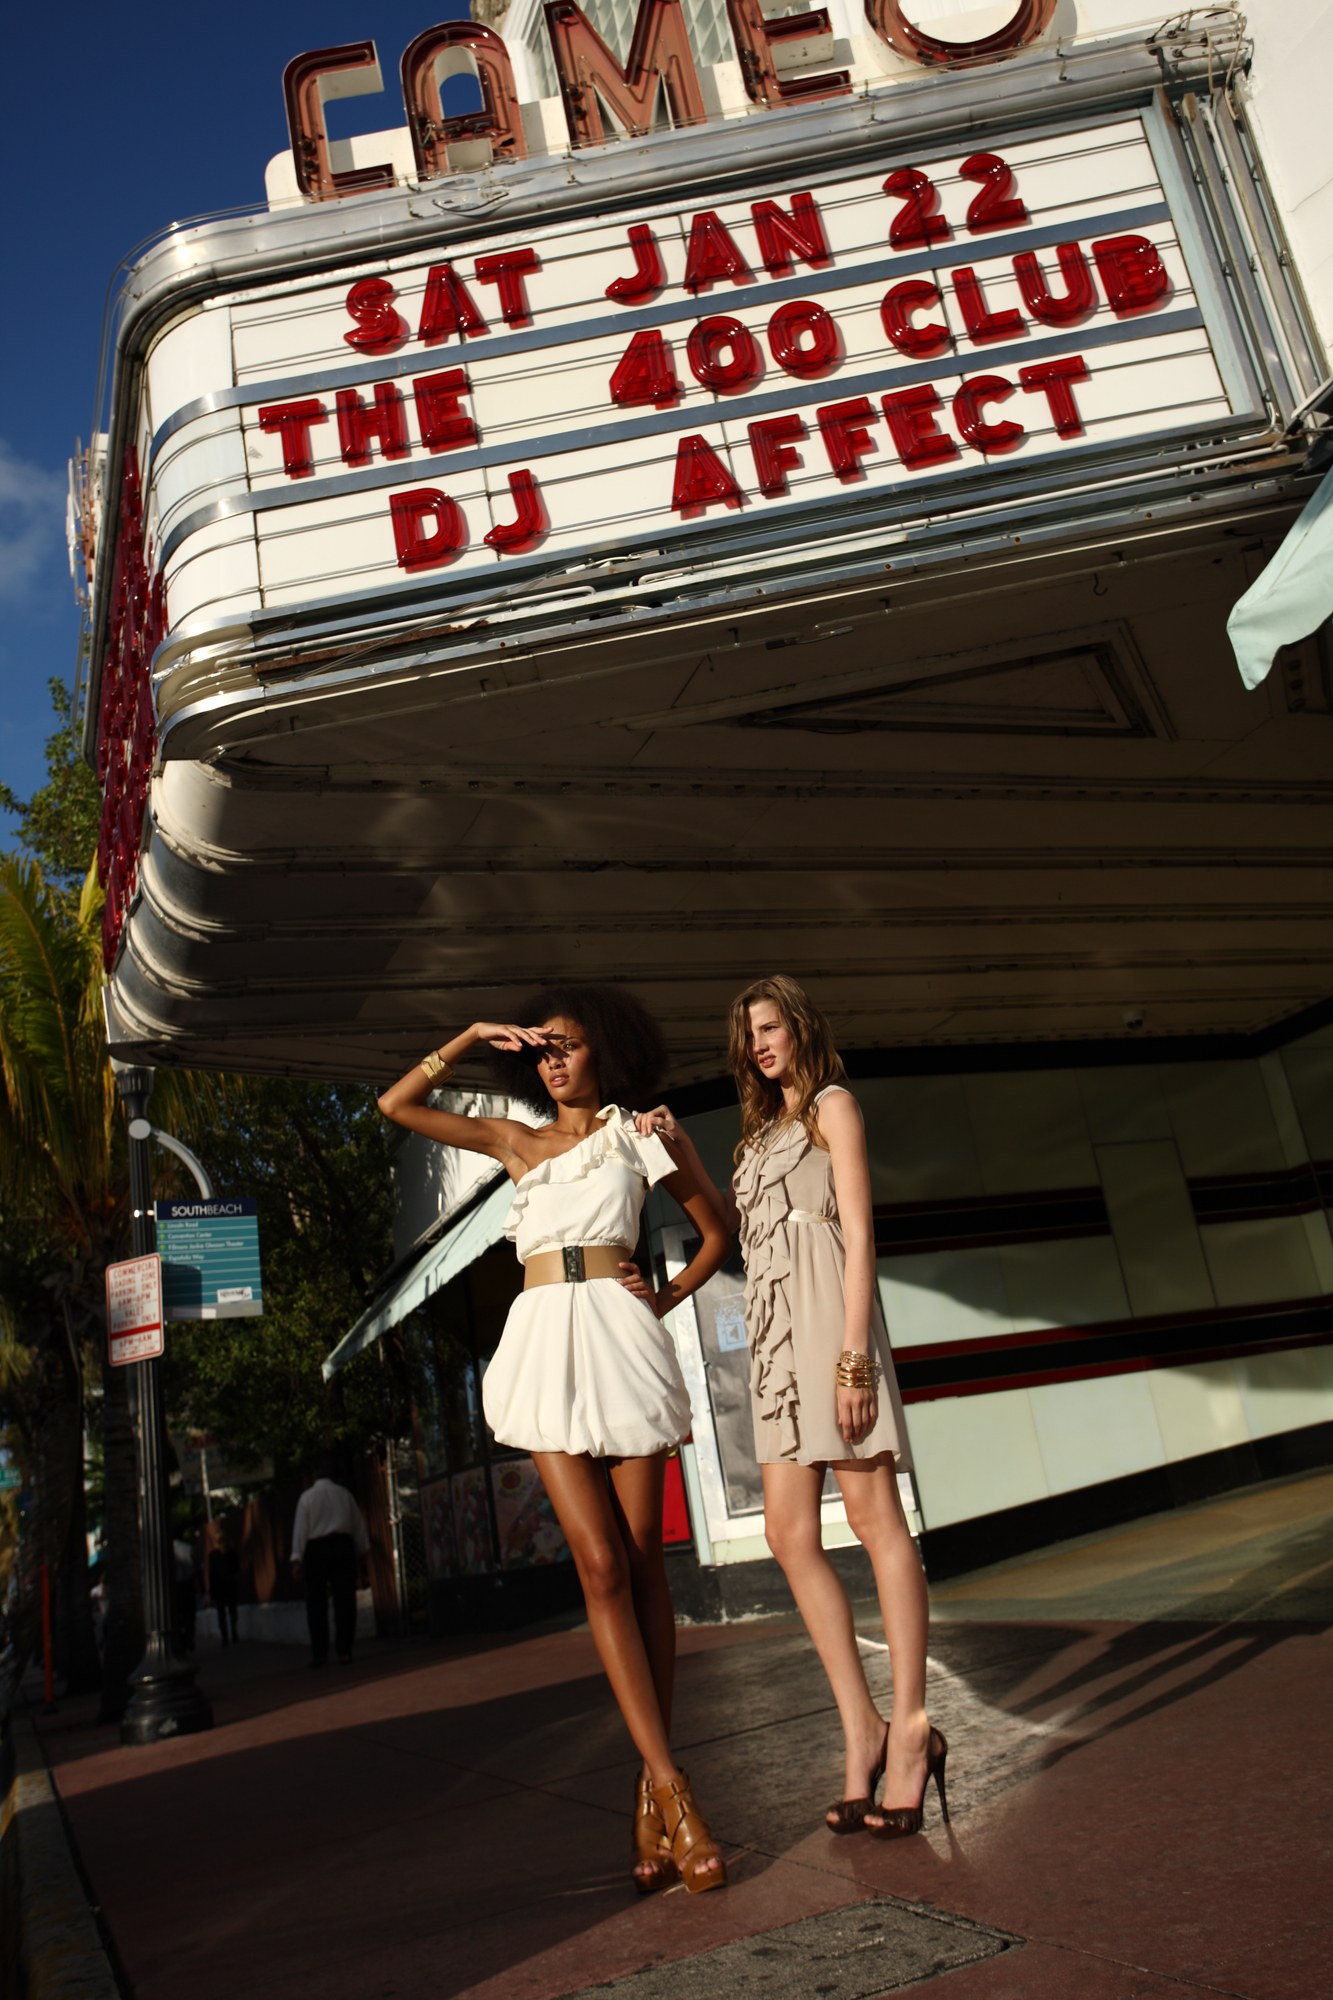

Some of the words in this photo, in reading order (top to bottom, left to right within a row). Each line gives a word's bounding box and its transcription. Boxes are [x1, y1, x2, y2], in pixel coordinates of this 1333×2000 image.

[258, 368, 479, 479] THE
[609, 300, 844, 410] 400
[879, 234, 1173, 358] CLUB
[344, 248, 538, 355] SAT
[605, 193, 833, 305] JAN
[882, 153, 1028, 251] 22
[389, 469, 550, 573] DJ
[671, 355, 1092, 520] AFFECT
[171, 1203, 242, 1217] SOUTHBEACH
